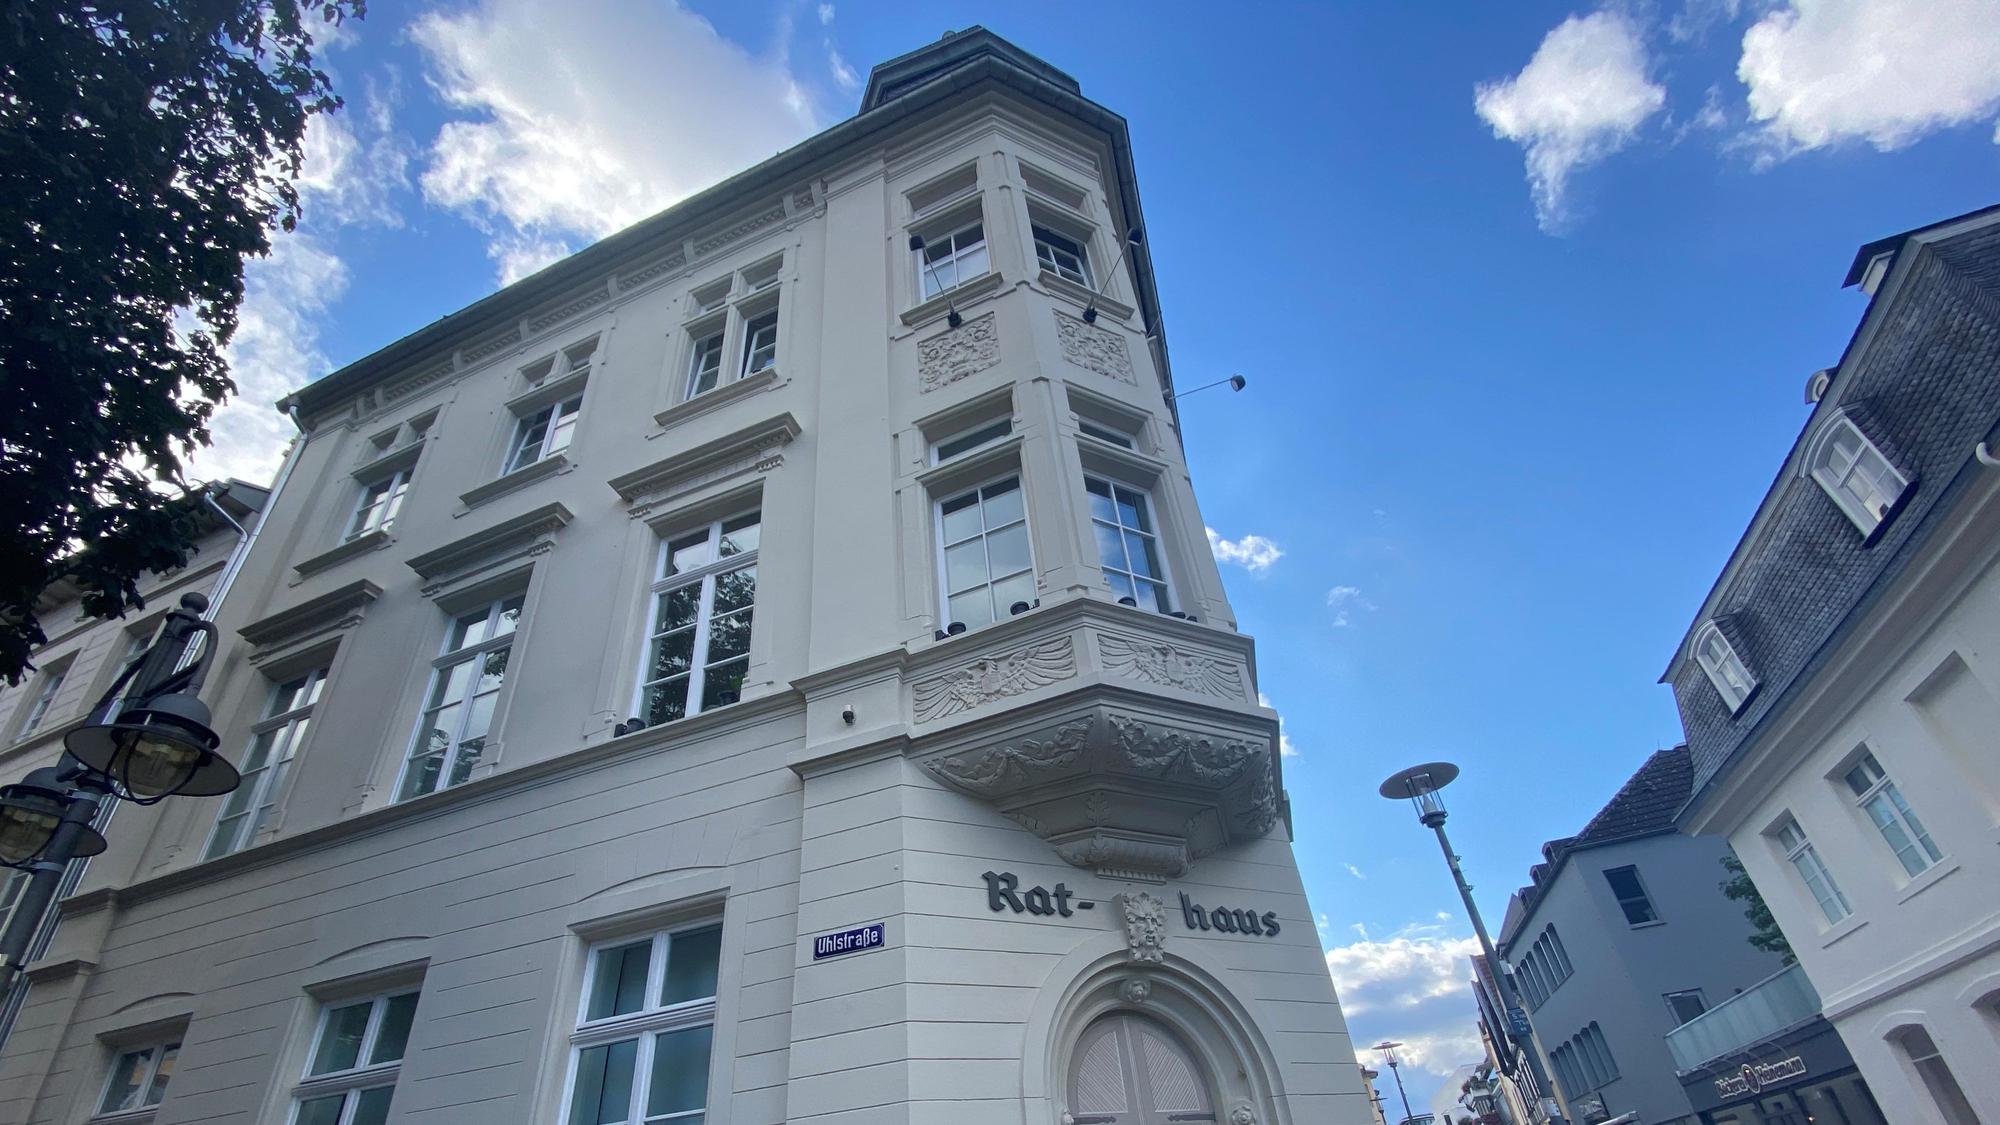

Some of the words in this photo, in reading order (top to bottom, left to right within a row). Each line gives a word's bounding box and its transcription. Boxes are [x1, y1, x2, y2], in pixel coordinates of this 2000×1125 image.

[981, 870, 1095, 917] Rat-
[1178, 889, 1281, 937] haus
[817, 928, 879, 954] Uhlstraße
[1754, 1056, 1806, 1085] Heinemann
